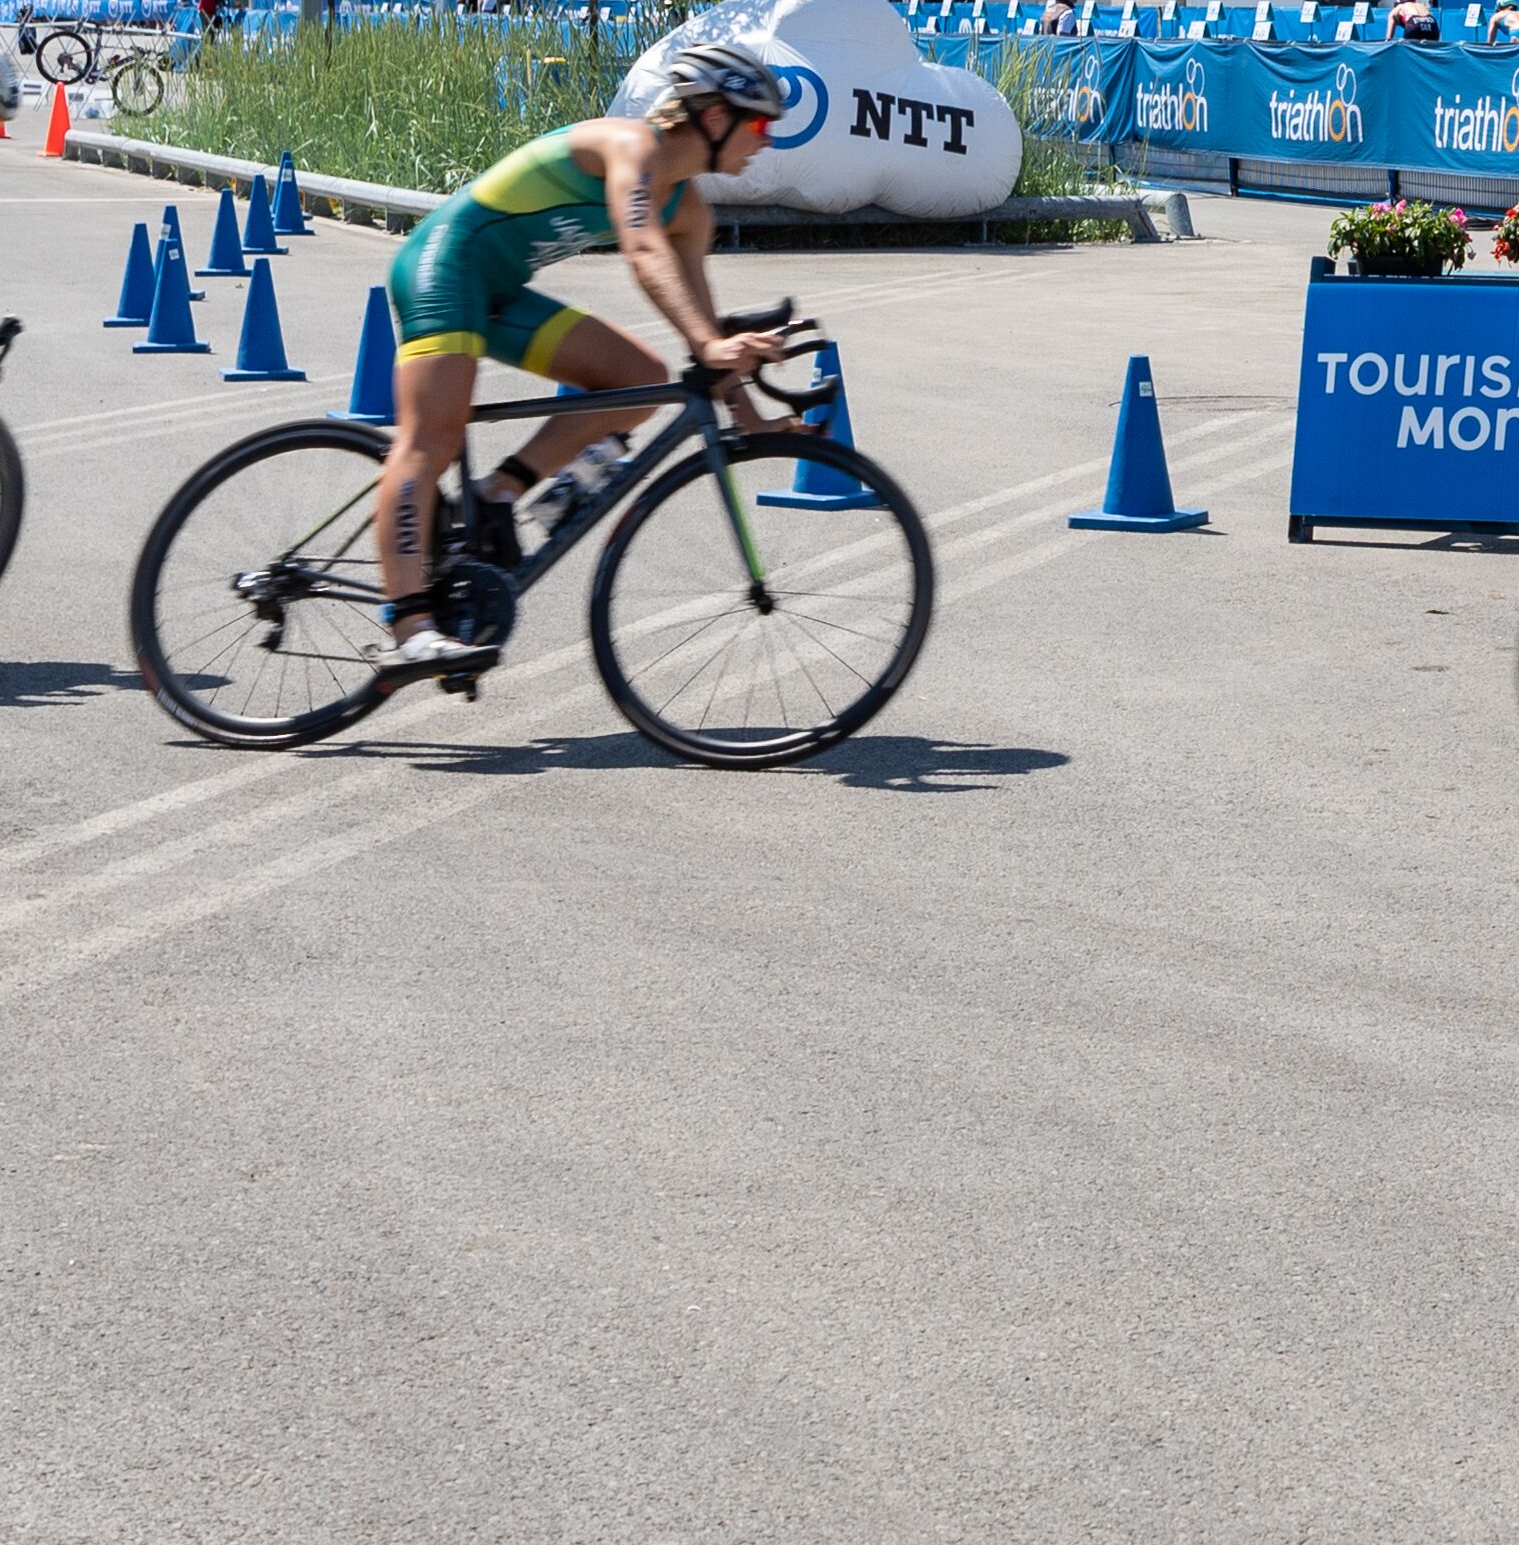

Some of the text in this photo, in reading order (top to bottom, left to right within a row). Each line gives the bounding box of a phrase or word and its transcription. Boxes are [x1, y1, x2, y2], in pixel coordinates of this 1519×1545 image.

[850, 88, 974, 155] NTT
[1136, 83, 1208, 132] triathlon
[1270, 89, 1363, 142] triathlon
